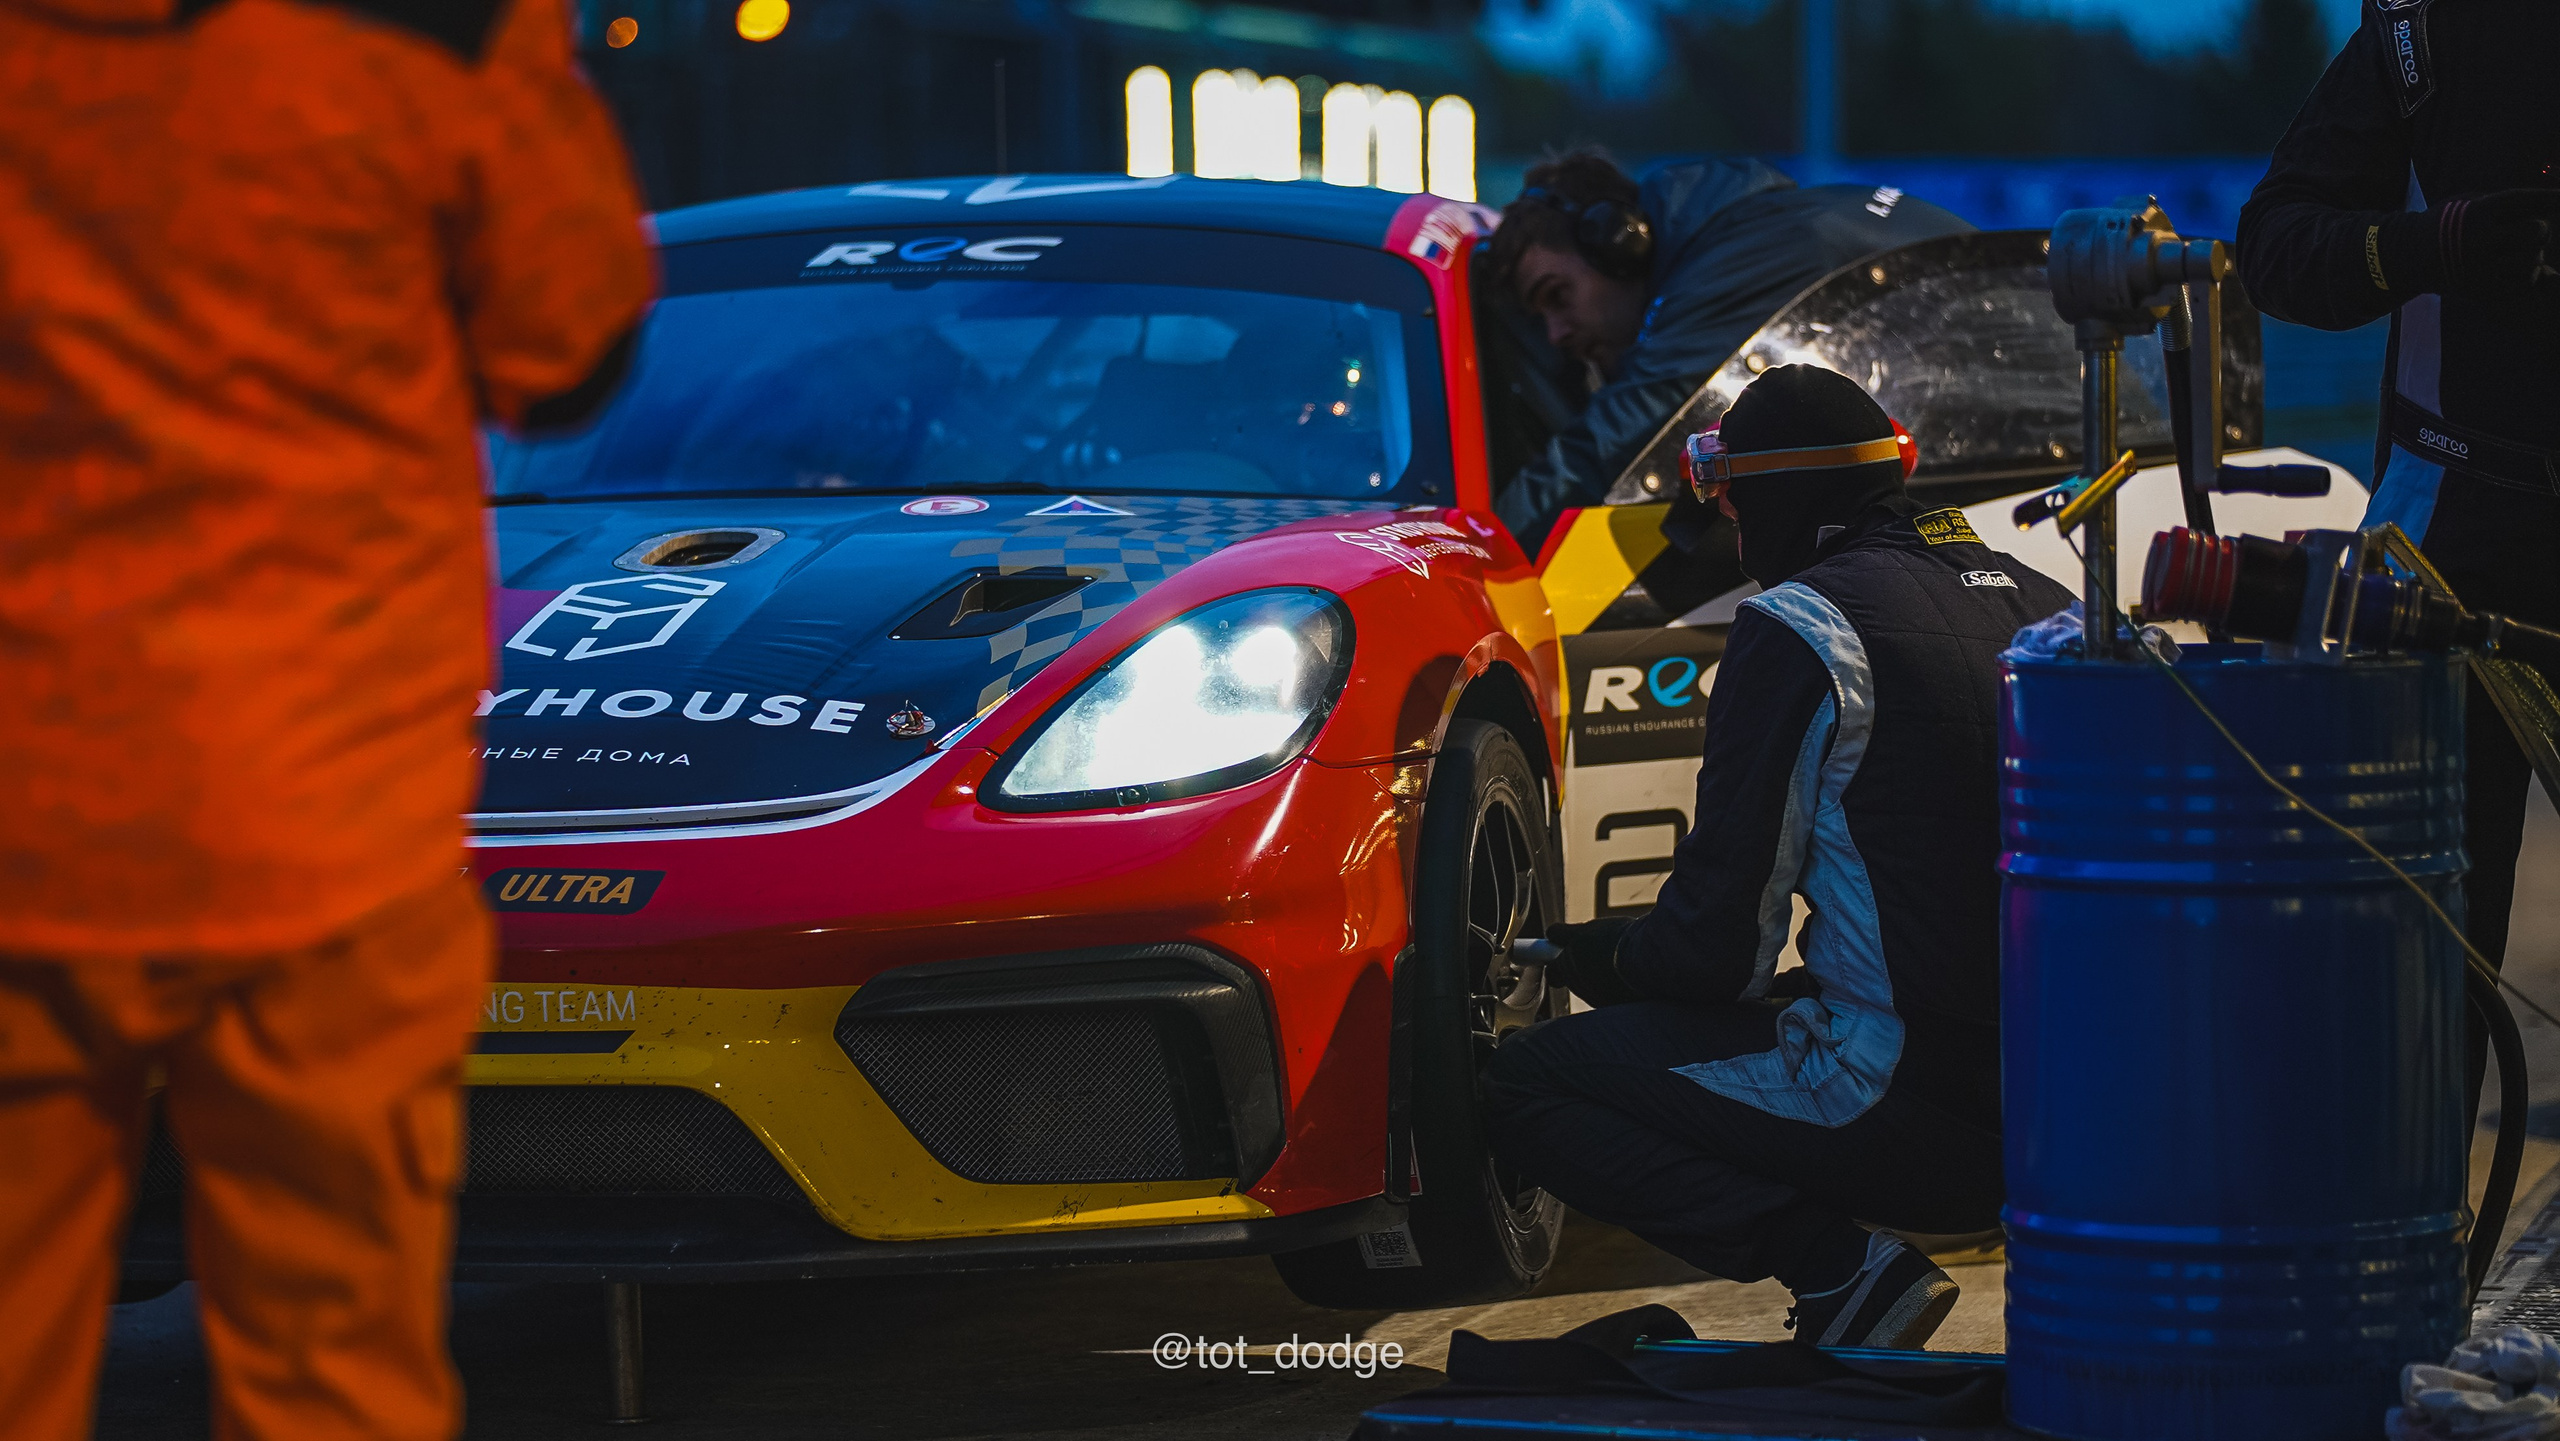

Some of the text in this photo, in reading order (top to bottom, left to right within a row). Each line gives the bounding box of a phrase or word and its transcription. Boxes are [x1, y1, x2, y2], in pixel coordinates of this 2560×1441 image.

[2394, 20, 2419, 84] sparco
[2419, 427, 2469, 454] sparco
[1585, 722, 1630, 736] RUSSIAN
[1633, 716, 1695, 733] ENDURANCE
[576, 749, 691, 766] ДОМА
[499, 874, 636, 905] ULTRA
[533, 989, 636, 1023] TEAM
